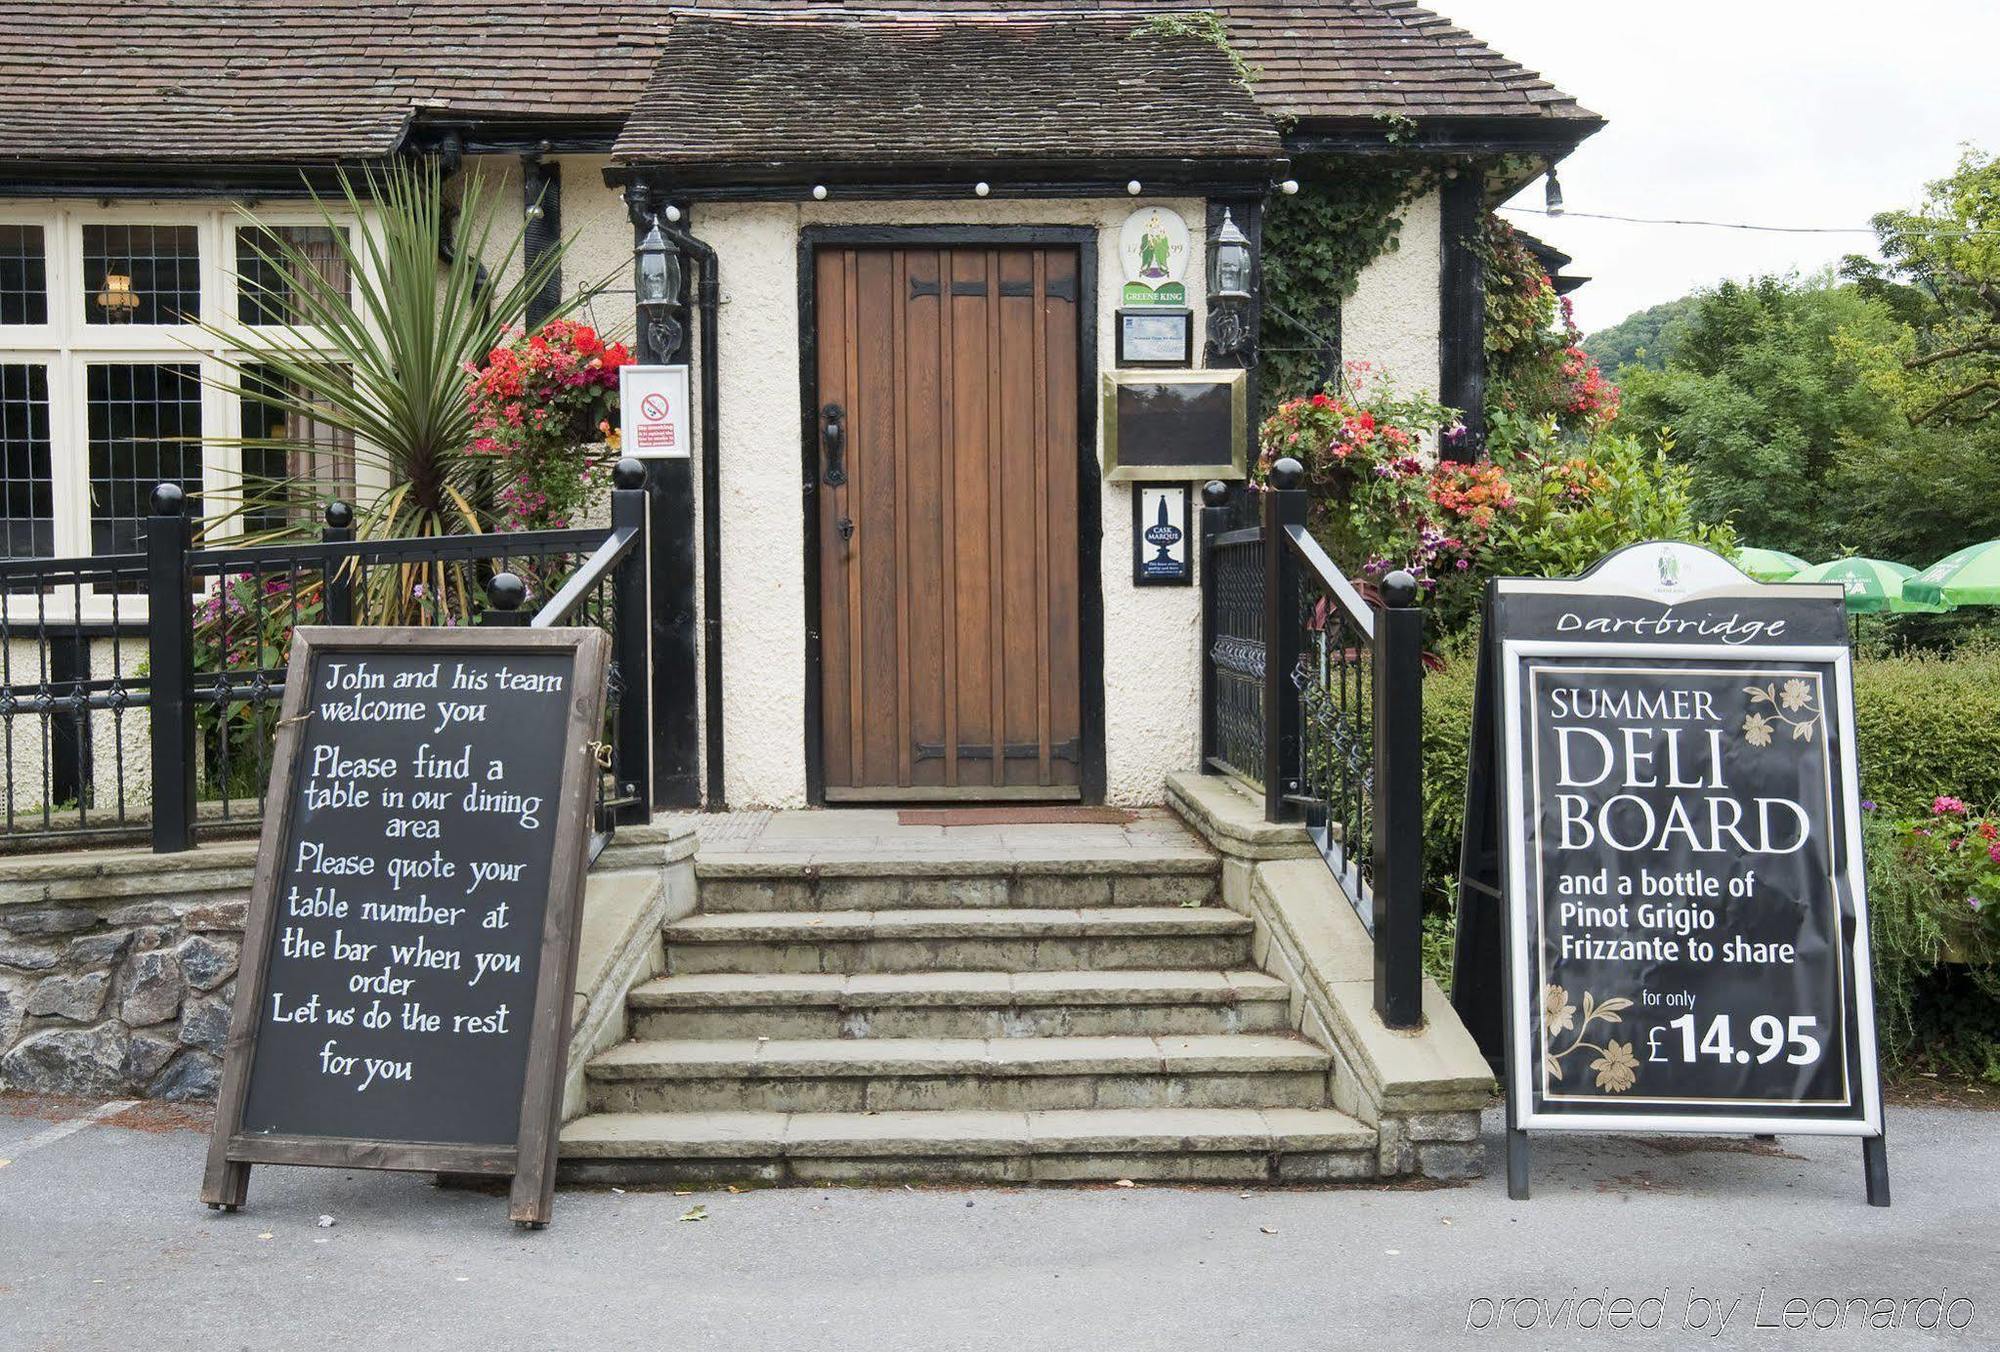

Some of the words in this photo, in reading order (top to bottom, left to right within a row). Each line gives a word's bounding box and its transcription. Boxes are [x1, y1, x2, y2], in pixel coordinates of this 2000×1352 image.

[1126, 292, 1159, 302] GREENE
[1160, 292, 1183, 302] KING
[1556, 608, 1785, 644] Dartbridge
[325, 662, 386, 690] John
[392, 663, 440, 689] and
[451, 663, 488, 691] his
[494, 666, 563, 693] team
[320, 693, 426, 722] welcome
[434, 701, 487, 734] you
[1551, 688, 1722, 721] SUMMER
[311, 744, 397, 778] Please
[412, 743, 472, 780] find
[486, 760, 503, 781] a
[1552, 726, 1729, 789] DELI
[303, 779, 370, 811] table
[382, 792, 404, 809] in
[411, 791, 453, 811] our
[463, 782, 543, 829] dining
[385, 818, 441, 839] area
[1554, 794, 1811, 854] BOARD
[295, 840, 375, 876] Please
[387, 850, 456, 891] quote
[466, 862, 528, 894] your
[1558, 869, 1608, 895] and
[1617, 875, 1632, 896] a
[1641, 868, 1720, 897] bottle
[1728, 870, 1755, 898] of
[287, 886, 349, 919] table
[360, 894, 466, 926] number
[482, 902, 510, 929] at
[1560, 900, 1629, 928] Pinot
[1637, 903, 1715, 936] Grigio
[281, 926, 326, 959] the
[333, 929, 378, 962] bar
[390, 938, 461, 971] when
[468, 953, 521, 987] you
[1561, 934, 1680, 961] Frizzante
[1687, 937, 1714, 962] to
[1722, 937, 1795, 964] share
[349, 968, 415, 995] order
[1642, 988, 1662, 1006] for
[1666, 990, 1696, 1010] only
[272, 992, 321, 1024] Let
[326, 1007, 356, 1026] us
[362, 999, 392, 1029] do
[401, 1002, 441, 1032] the
[452, 1003, 510, 1034] rest
[1646, 1013, 1821, 1066] £14.95
[319, 1039, 358, 1076] for
[357, 1058, 413, 1092] you
